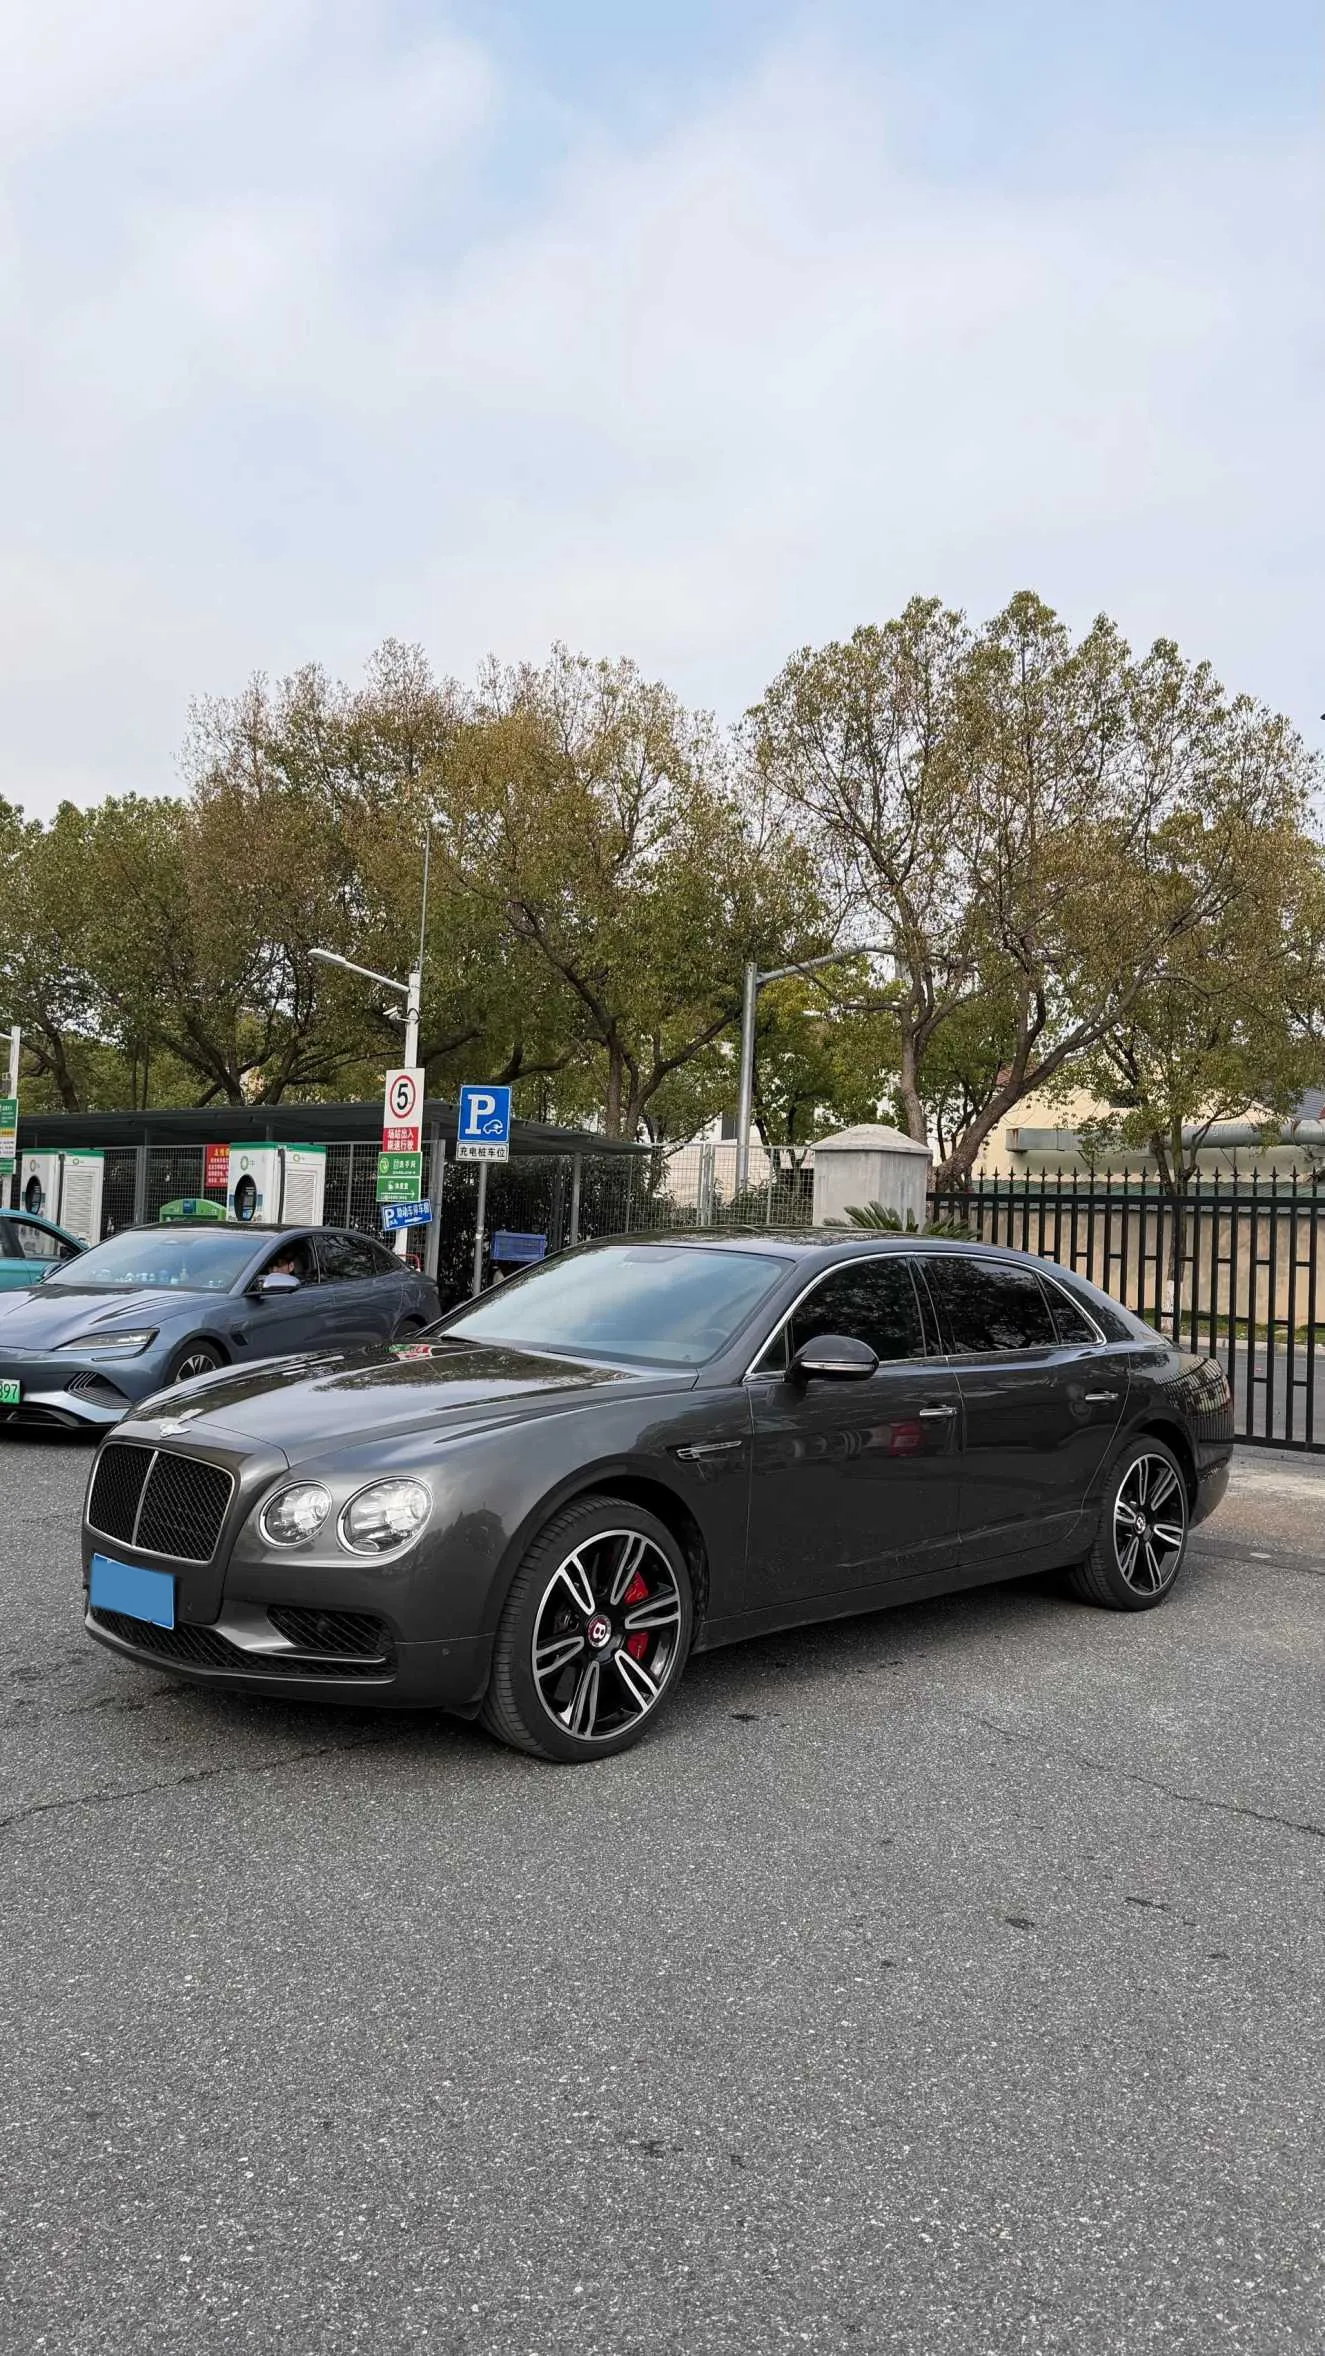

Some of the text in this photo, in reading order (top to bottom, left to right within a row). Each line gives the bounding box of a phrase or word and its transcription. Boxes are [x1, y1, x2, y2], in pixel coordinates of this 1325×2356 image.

[396, 1083, 409, 1110] 5
[465, 1094, 496, 1135] P
[459, 1146, 505, 1158] 充电桩车位
[384, 1208, 395, 1228] P
